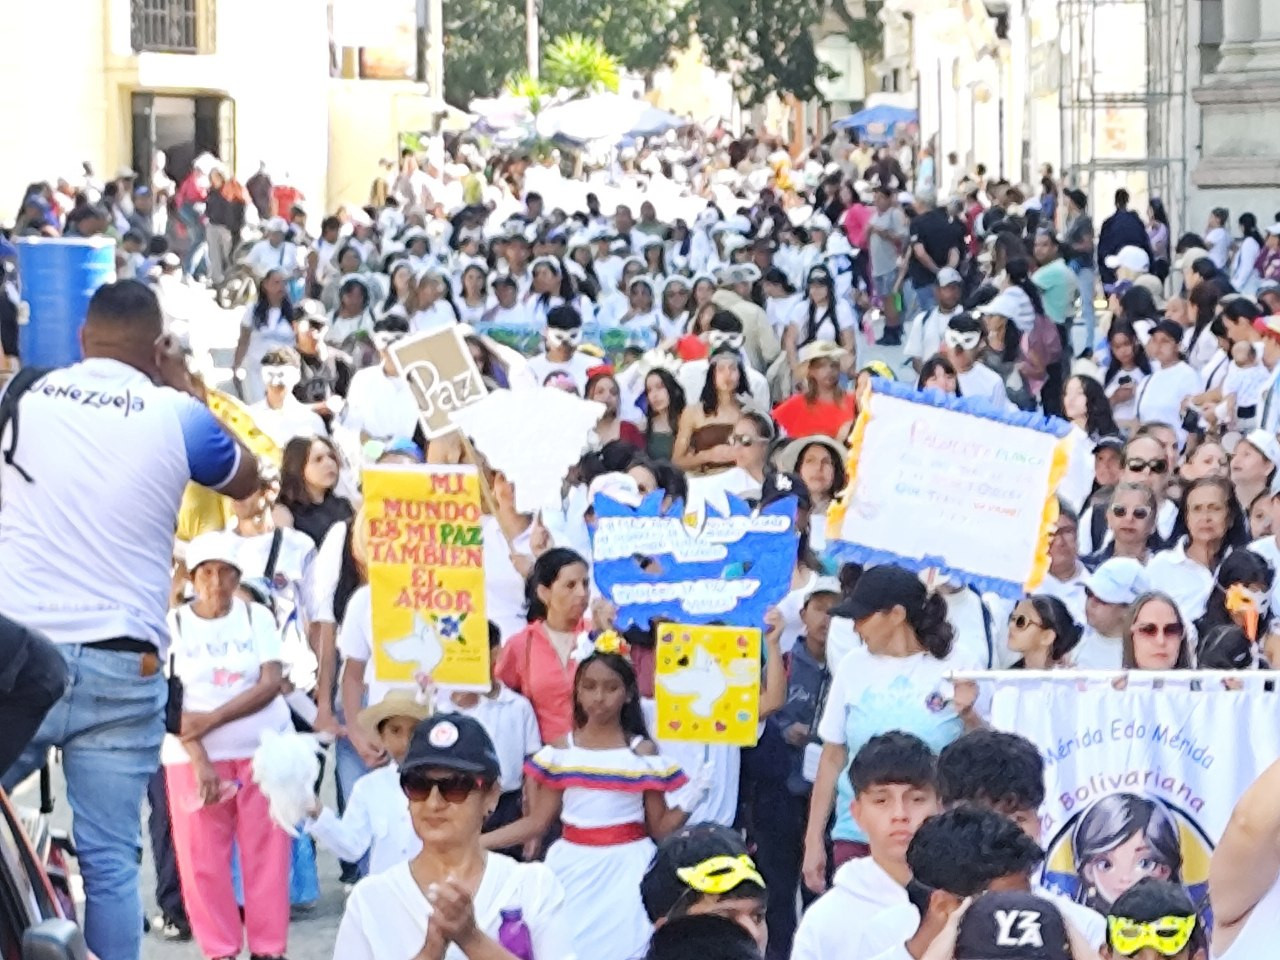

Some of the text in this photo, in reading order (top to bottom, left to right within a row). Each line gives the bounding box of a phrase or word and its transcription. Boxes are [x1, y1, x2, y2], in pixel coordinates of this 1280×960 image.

[401, 359, 484, 418] Paz
[431, 473, 466, 494] MI
[383, 498, 481, 522] MUNDO
[369, 519, 483, 546] ES MI PAZ
[370, 543, 483, 567] TAMBIEN
[394, 588, 475, 613] AMOR
[1111, 719, 1146, 740] Edo
[1151, 723, 1215, 769] Mérida
[1059, 765, 1205, 813] Bolivariana
